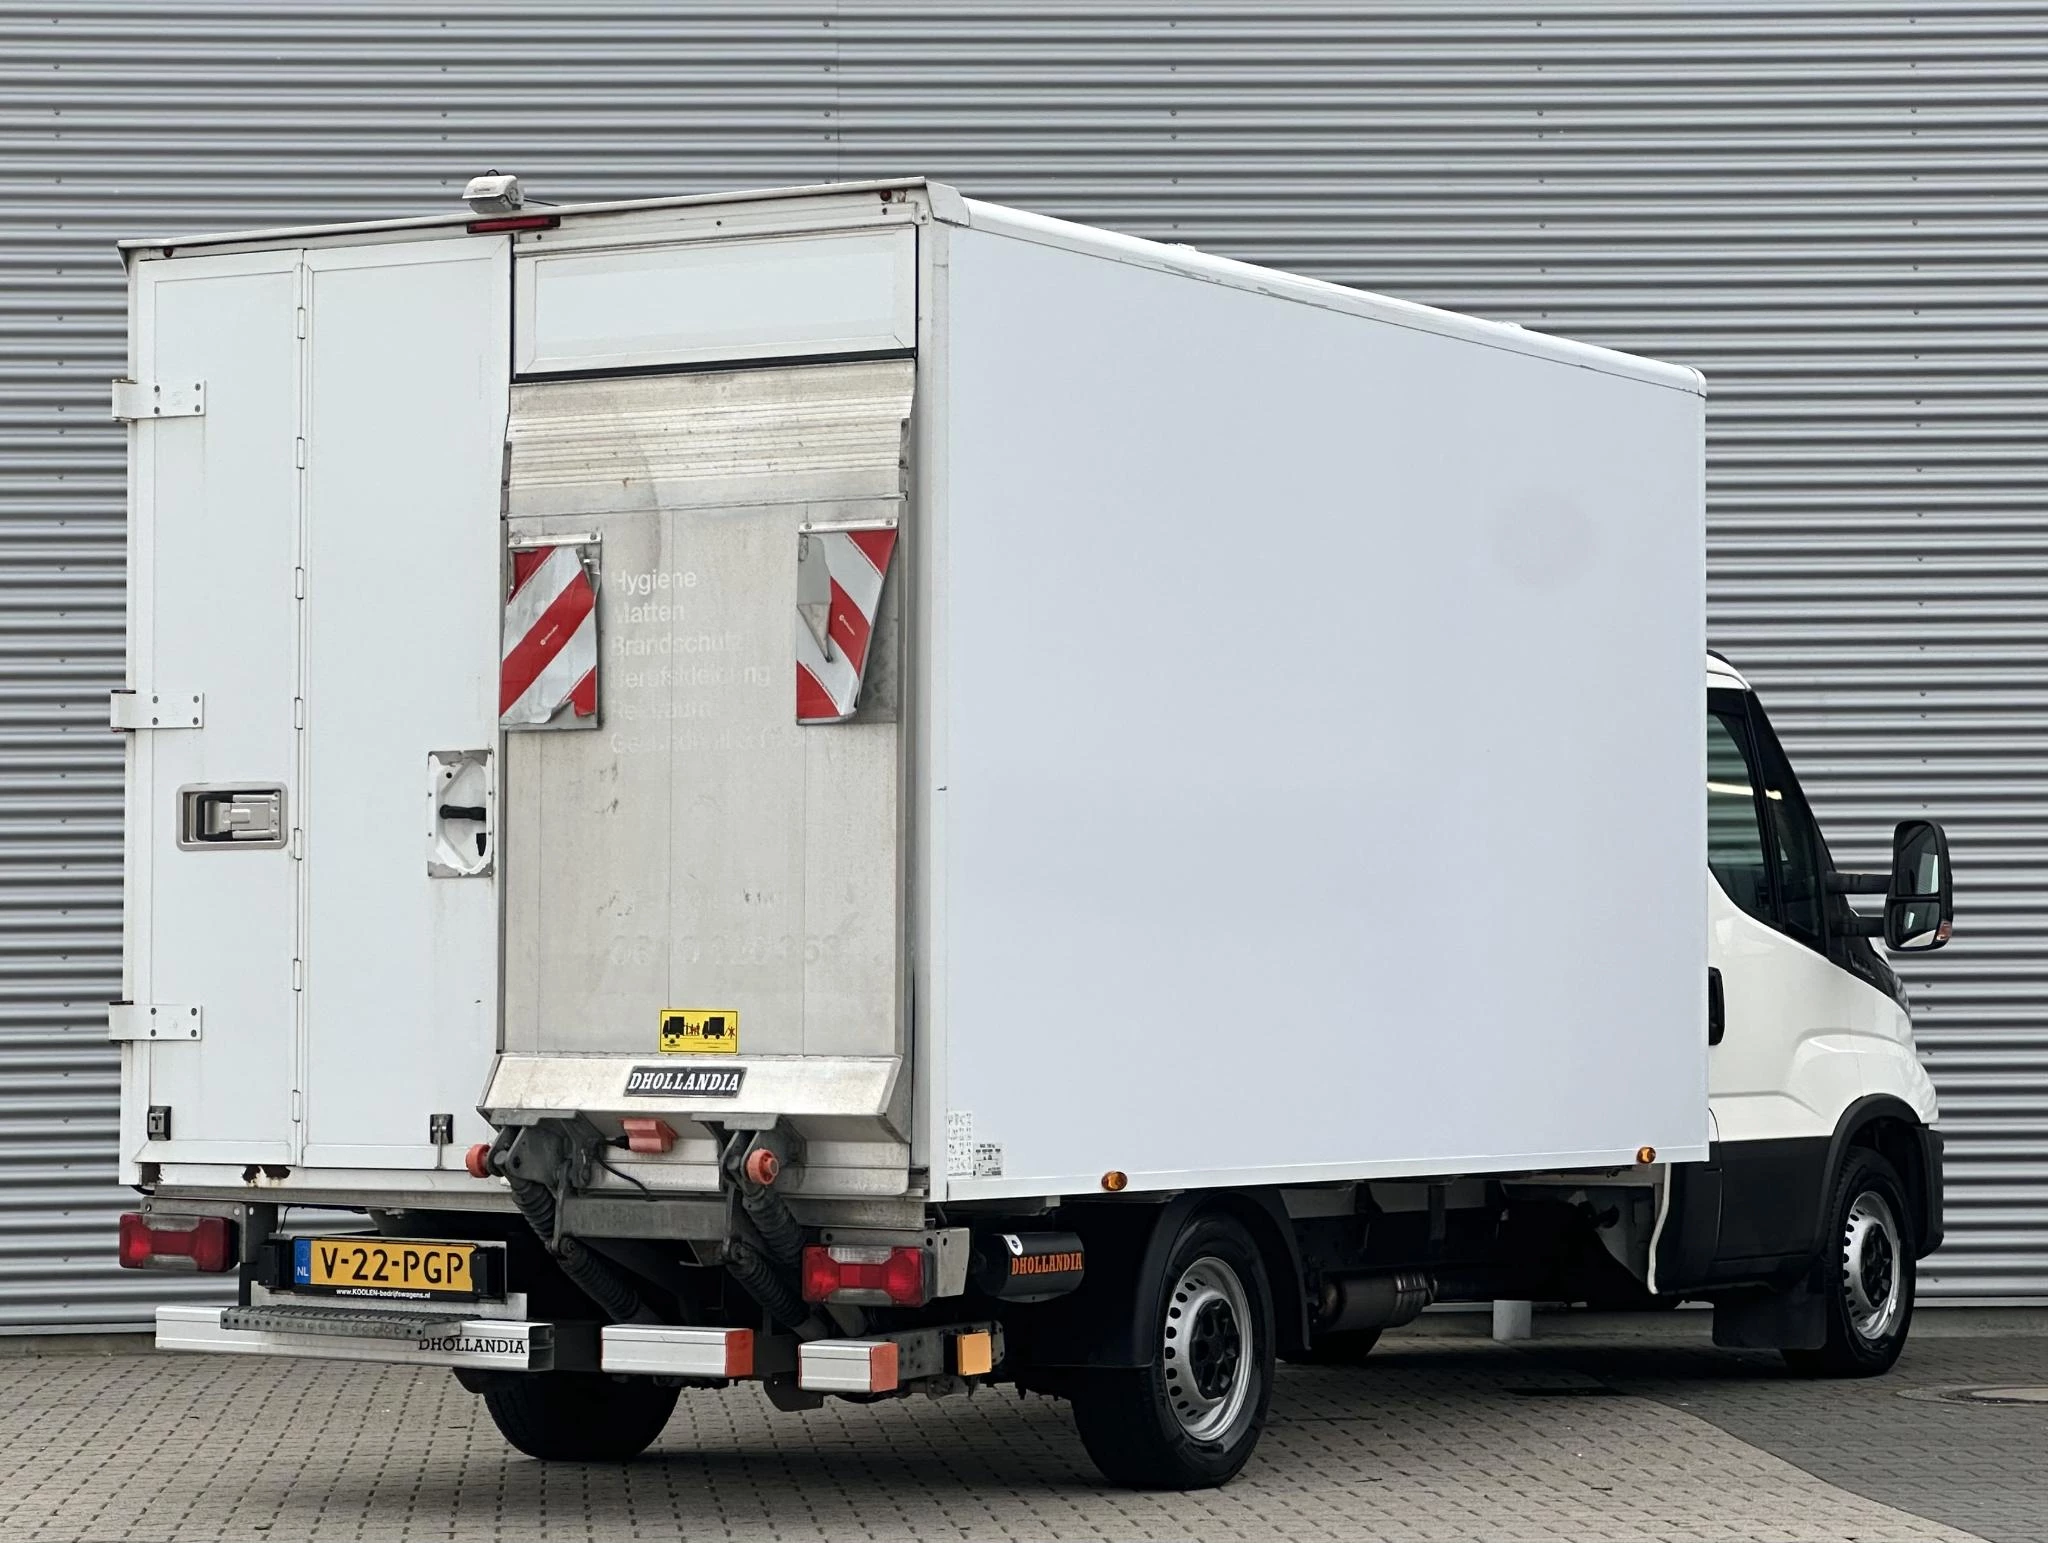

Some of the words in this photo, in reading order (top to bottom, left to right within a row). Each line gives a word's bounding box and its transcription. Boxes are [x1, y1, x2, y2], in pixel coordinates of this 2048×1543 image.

[627, 1072, 740, 1091] DHOLLANDIA
[296, 1266, 309, 1277] NL
[320, 1246, 464, 1285] V-22-PGP
[1011, 1252, 1083, 1275] DHOLLANDIA
[418, 1337, 526, 1354] DHOLLANDIA
